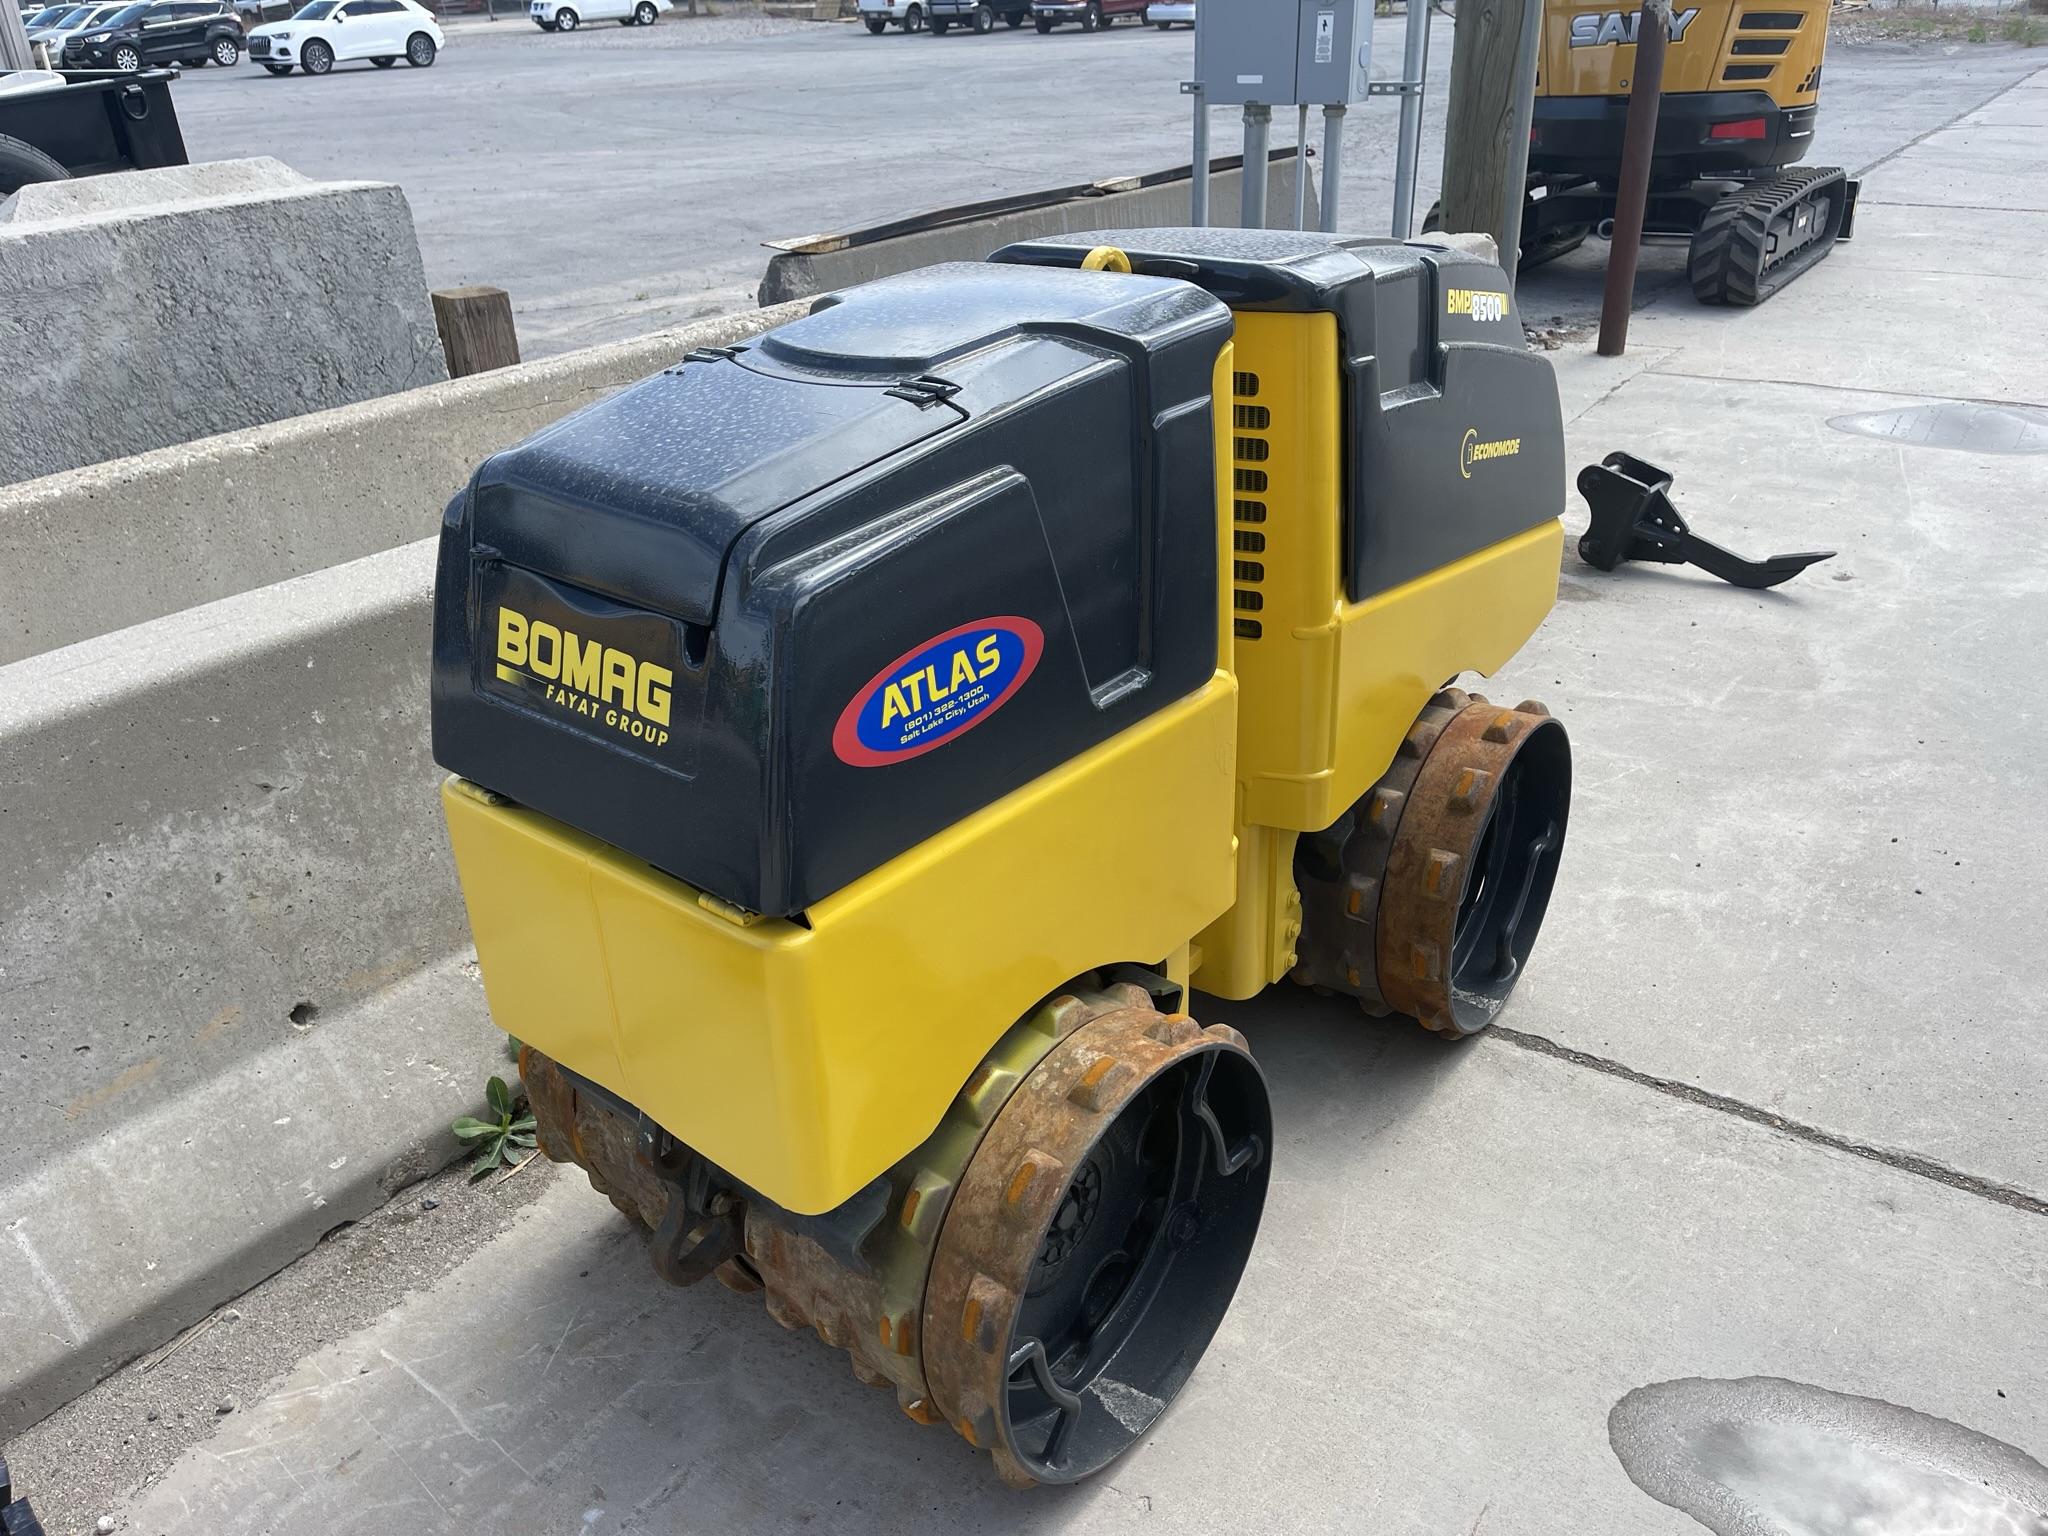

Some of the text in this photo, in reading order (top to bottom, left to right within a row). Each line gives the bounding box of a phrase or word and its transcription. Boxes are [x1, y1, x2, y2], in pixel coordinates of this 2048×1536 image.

[1472, 293, 1502, 322] 8500
[1473, 438, 1521, 461] ECONOMODE
[498, 606, 673, 727] BOMAG
[881, 633, 1001, 729] ATLAS
[546, 684, 669, 747] FAYAT GROUP
[900, 693, 990, 745] Salt Lake City, Utah
[904, 684, 984, 732] (801) 322-1300
